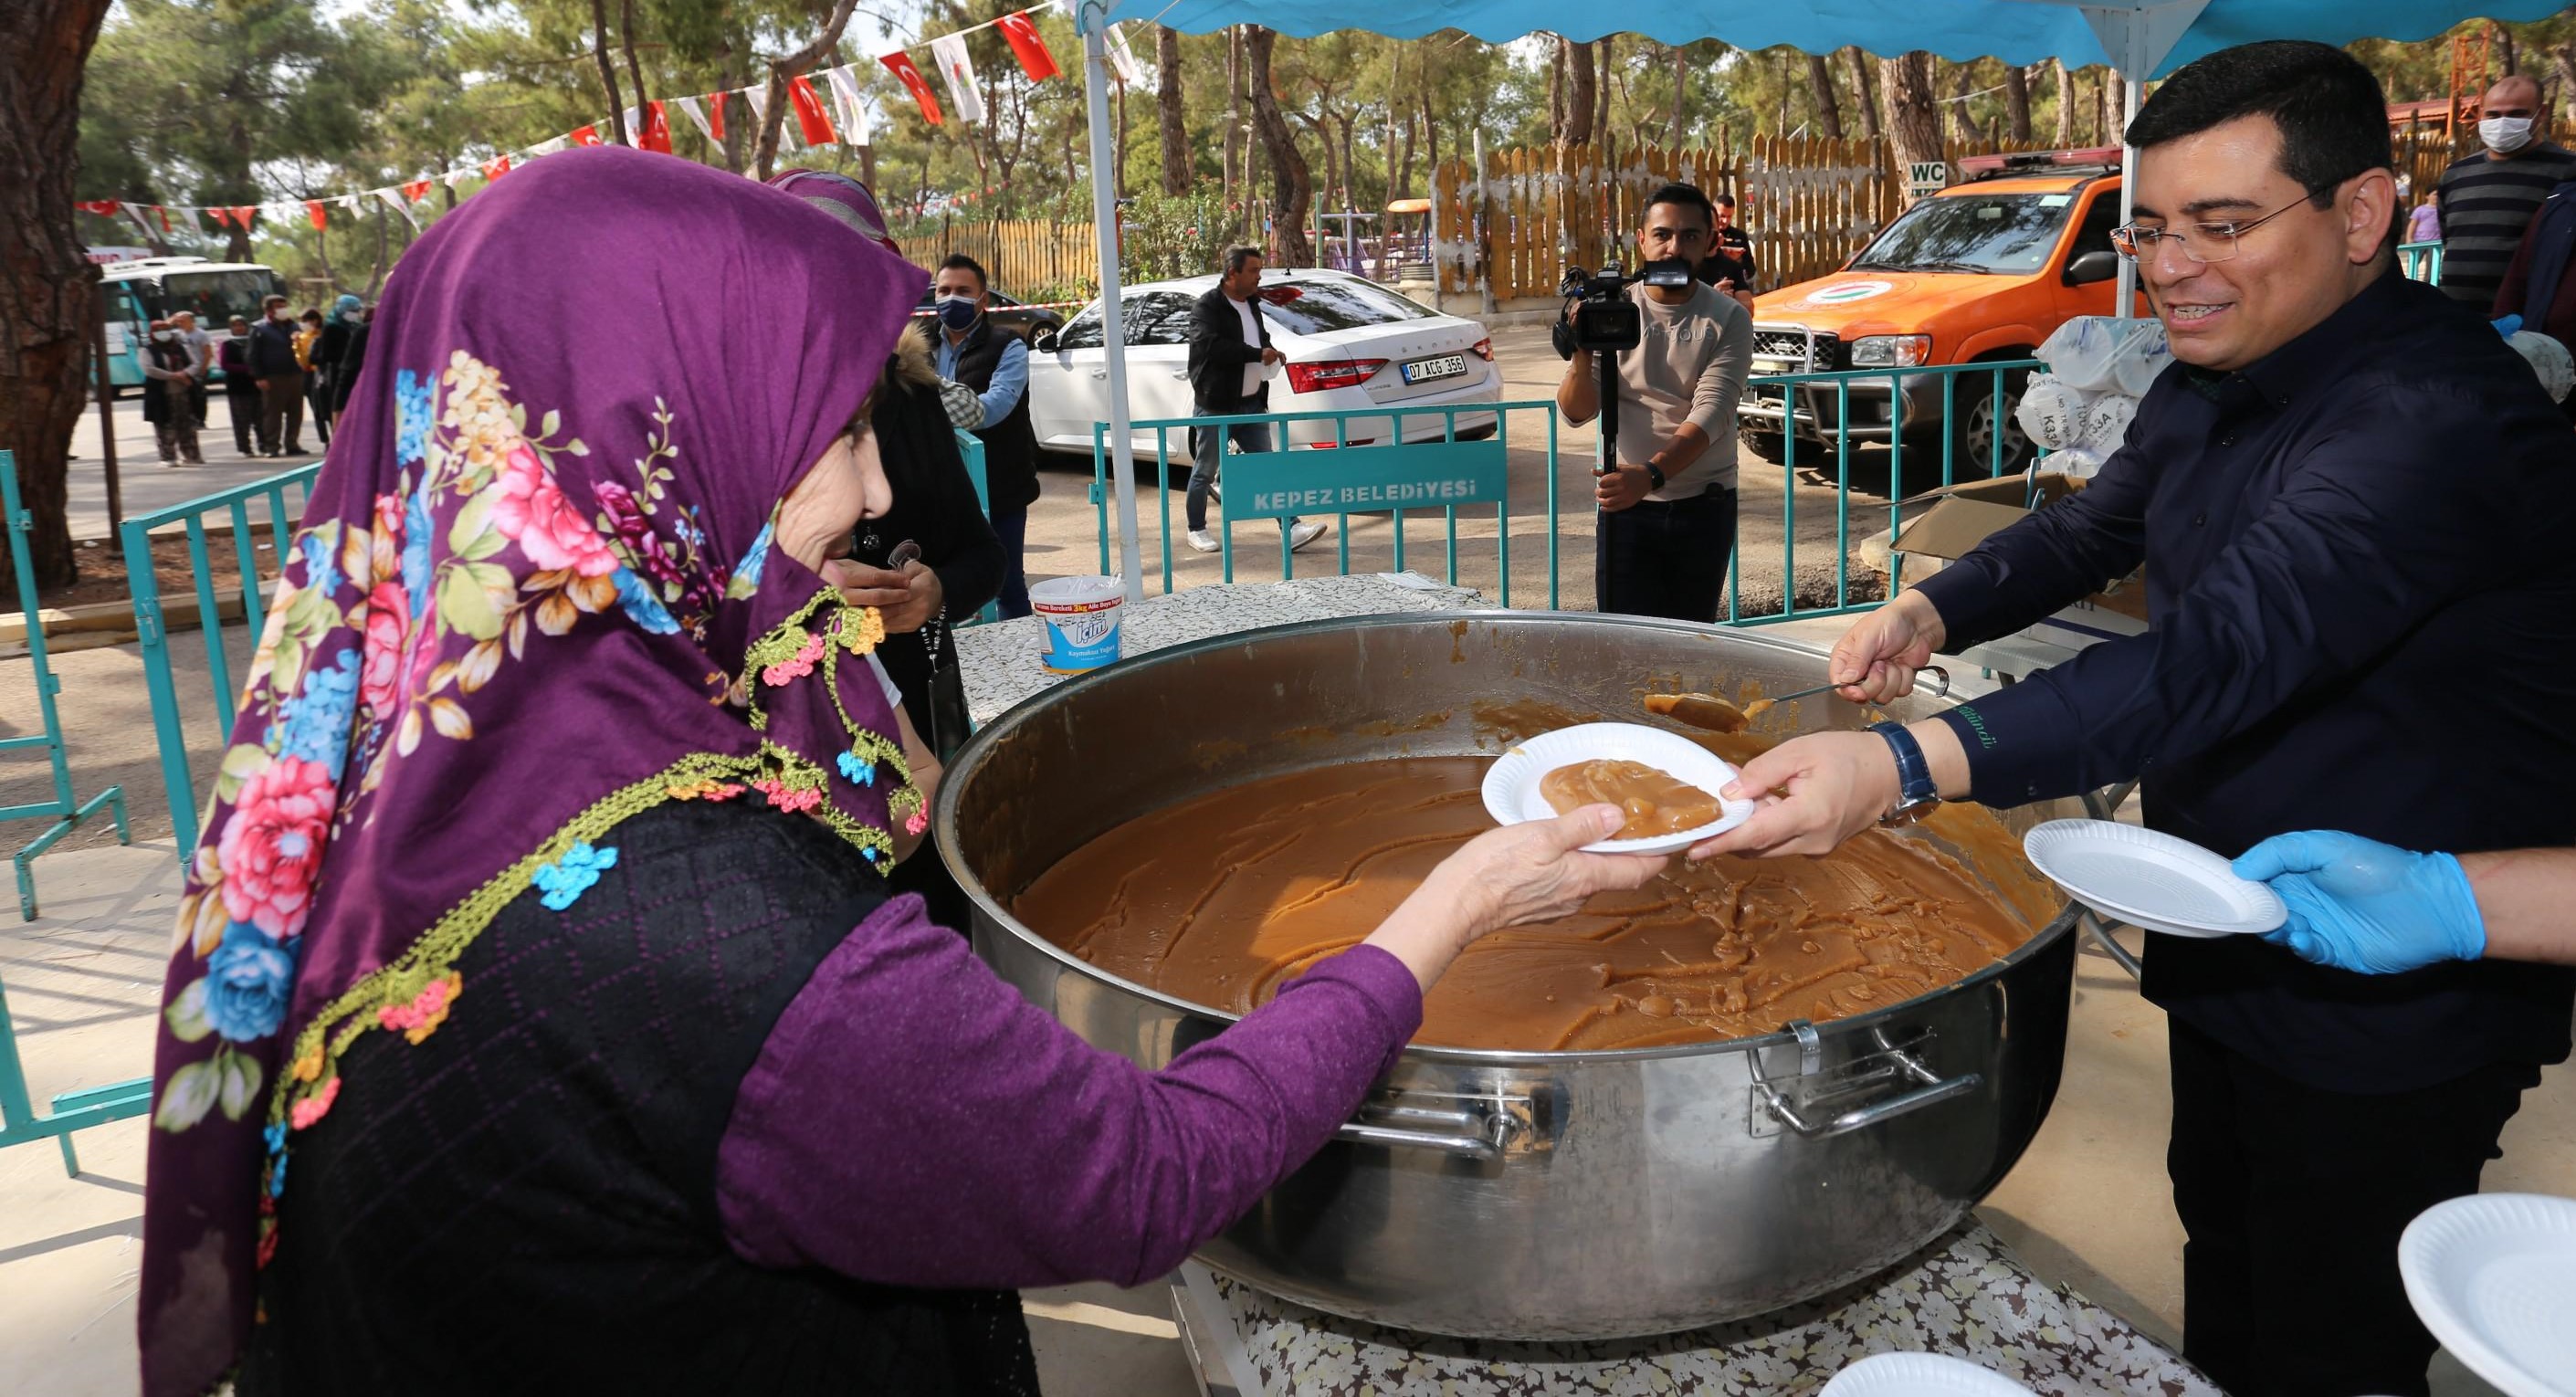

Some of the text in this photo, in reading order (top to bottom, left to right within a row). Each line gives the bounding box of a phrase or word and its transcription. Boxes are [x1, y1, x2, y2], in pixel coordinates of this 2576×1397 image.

[1911, 163, 1944, 182] WC
[1409, 363, 1421, 379] 07
[1425, 361, 1443, 375] ACG
[1445, 357, 1463, 373] 356
[1254, 488, 1334, 510] KEPEZ
[1073, 604, 1088, 613] 3kg
